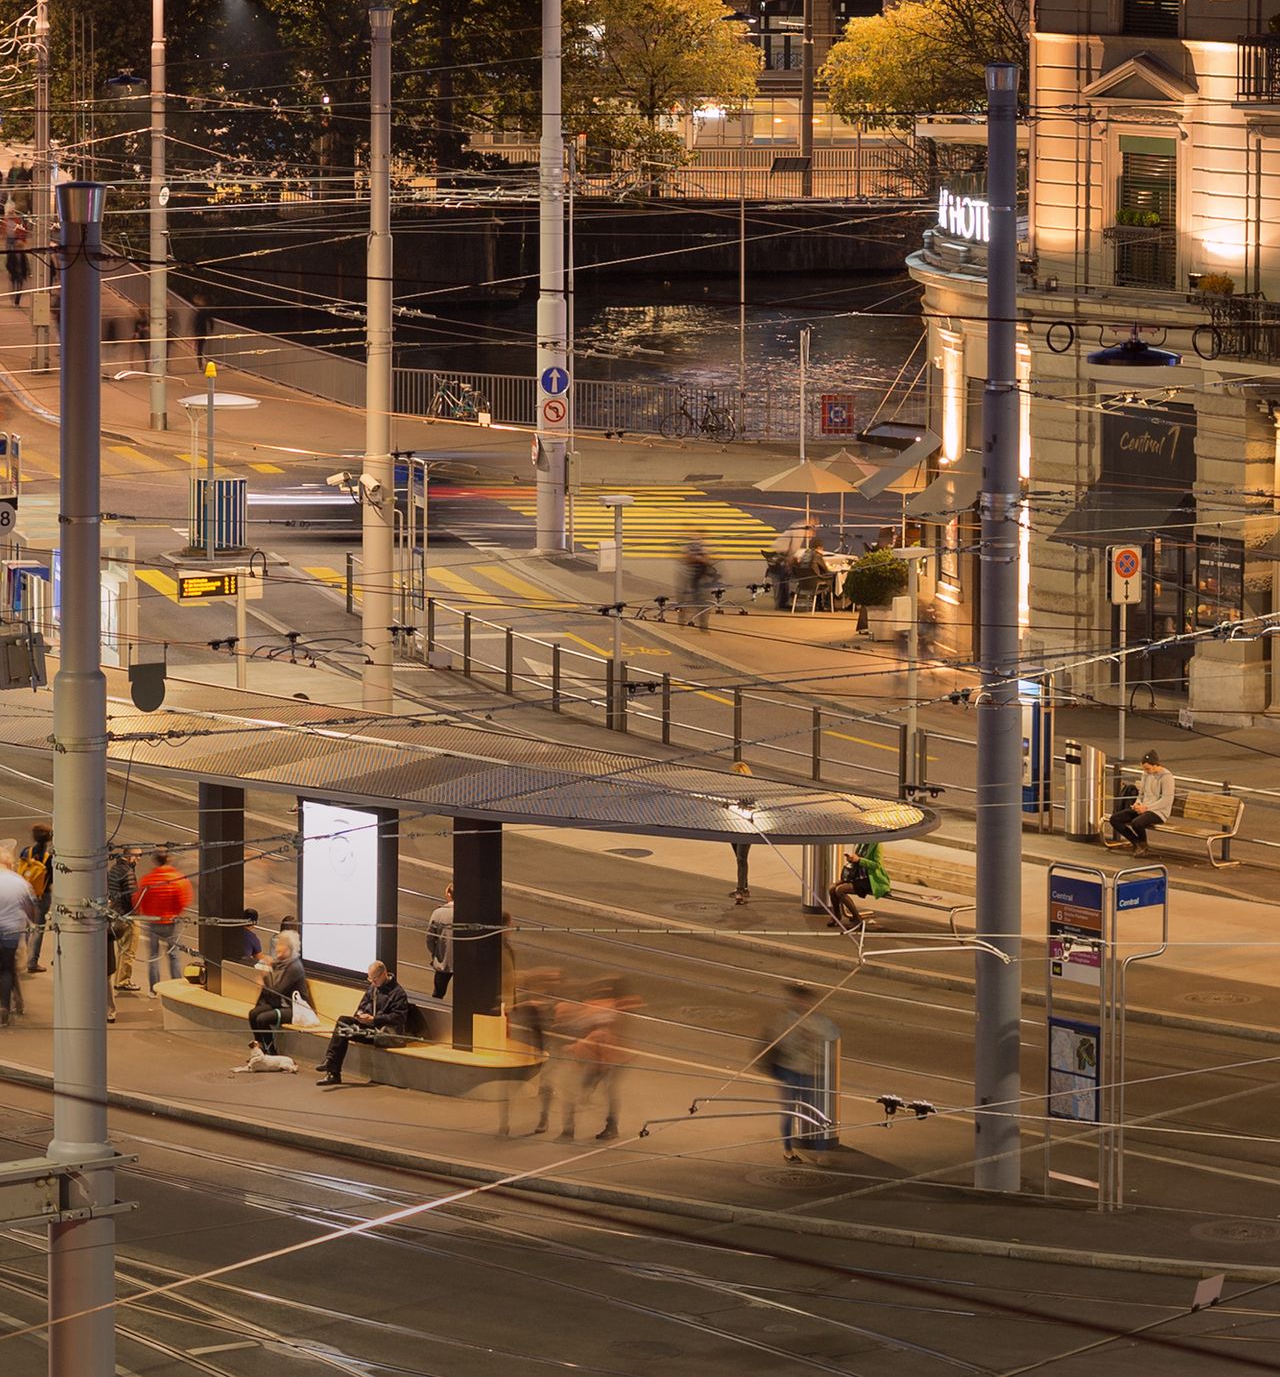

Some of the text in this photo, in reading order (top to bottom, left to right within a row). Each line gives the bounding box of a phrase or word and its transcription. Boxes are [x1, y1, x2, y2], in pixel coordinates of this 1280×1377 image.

[1120, 430, 1166, 455] Central
[1052, 891, 1073, 901] Central
[1120, 898, 1139, 907] Central
[1057, 911, 1063, 920] 6
